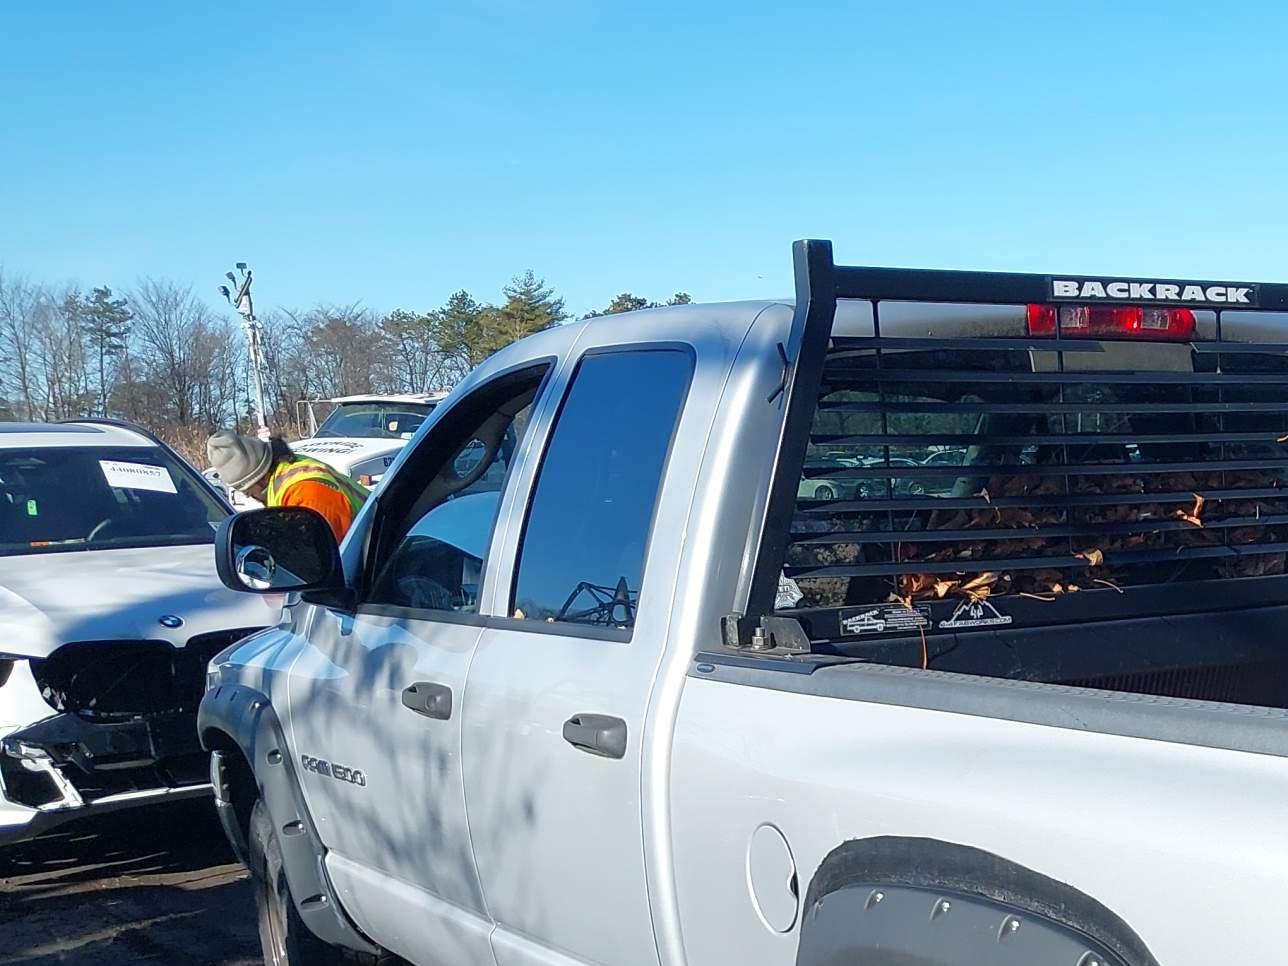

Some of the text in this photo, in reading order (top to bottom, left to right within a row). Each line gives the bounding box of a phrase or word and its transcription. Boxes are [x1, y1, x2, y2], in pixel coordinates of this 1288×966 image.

[1053, 281, 1251, 303] BACKRACK
[302, 754, 367, 787] RAM 1500
